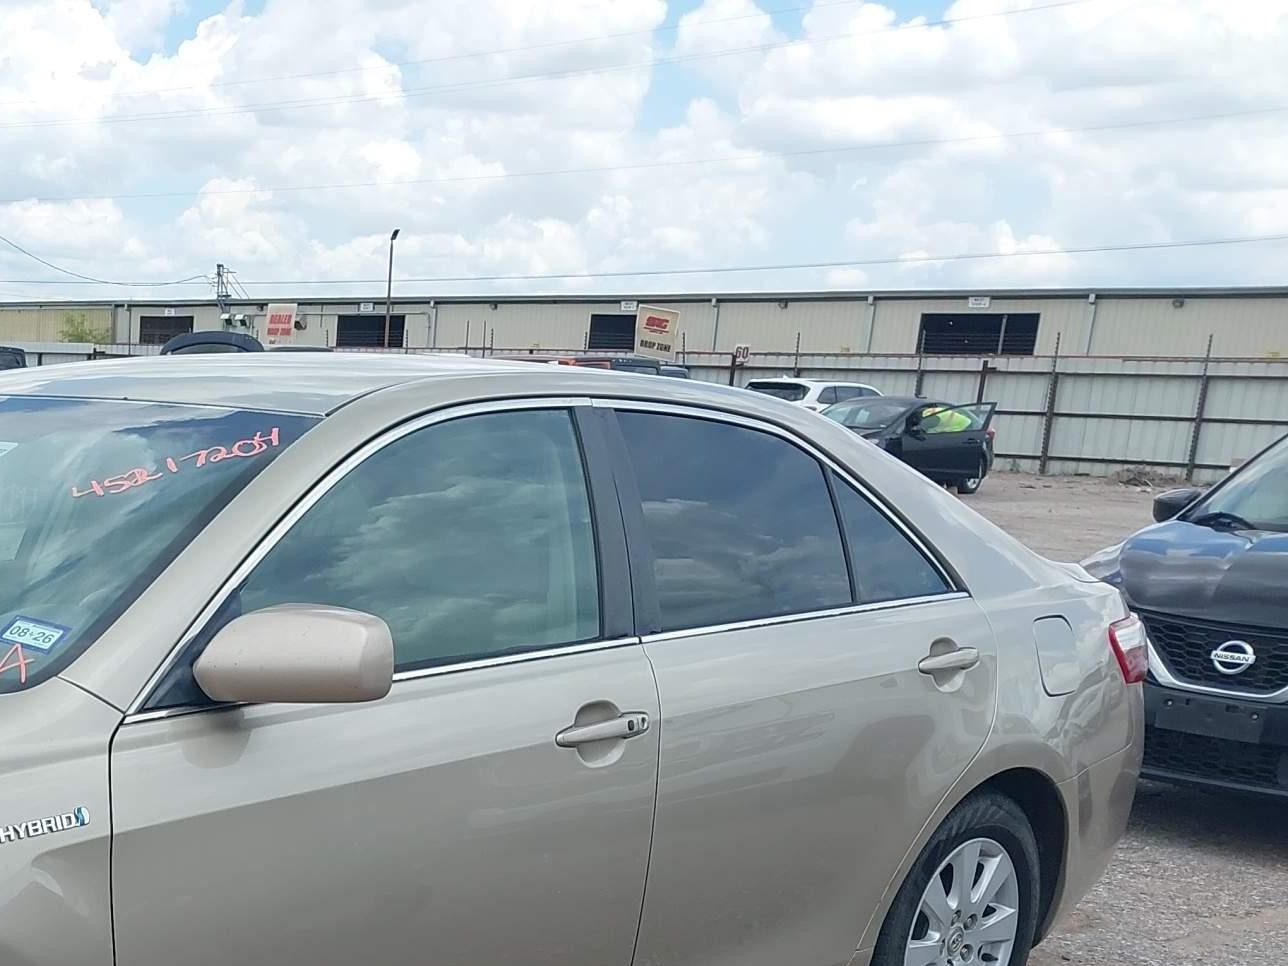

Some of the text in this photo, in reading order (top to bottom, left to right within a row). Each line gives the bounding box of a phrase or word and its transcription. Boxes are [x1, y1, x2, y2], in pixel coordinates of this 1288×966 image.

[639, 339, 671, 352] DROP ZONE
[735, 346, 749, 359] 60
[1214, 652, 1250, 662] NISSAN
